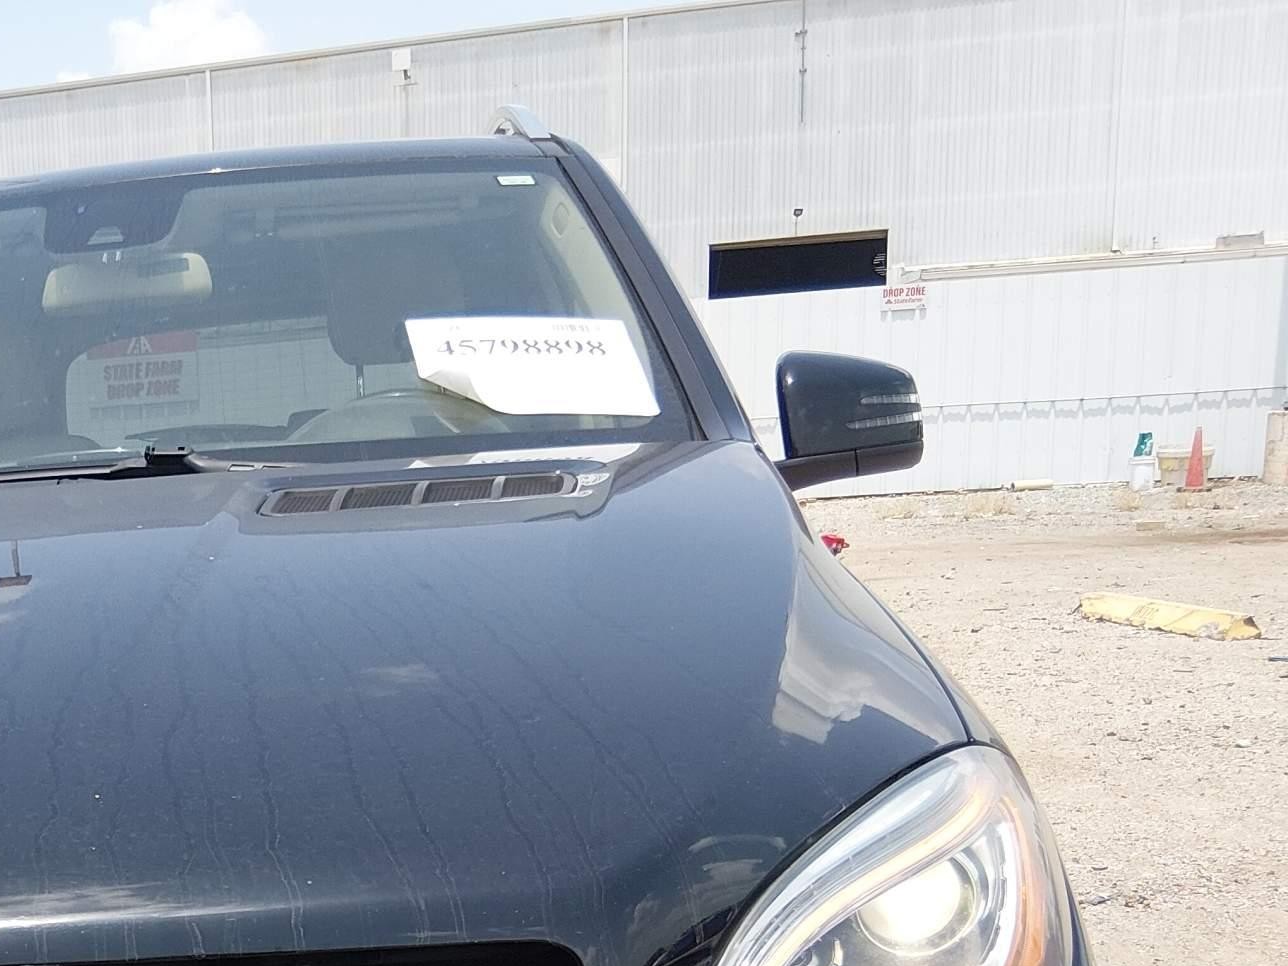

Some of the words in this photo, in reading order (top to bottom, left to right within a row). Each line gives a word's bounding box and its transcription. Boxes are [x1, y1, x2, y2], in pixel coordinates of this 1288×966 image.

[883, 287, 905, 298] DROP
[906, 286, 926, 296] ZONE
[437, 339, 607, 356] 45798898
[104, 362, 143, 380] STATE
[107, 382, 145, 400] DROP
